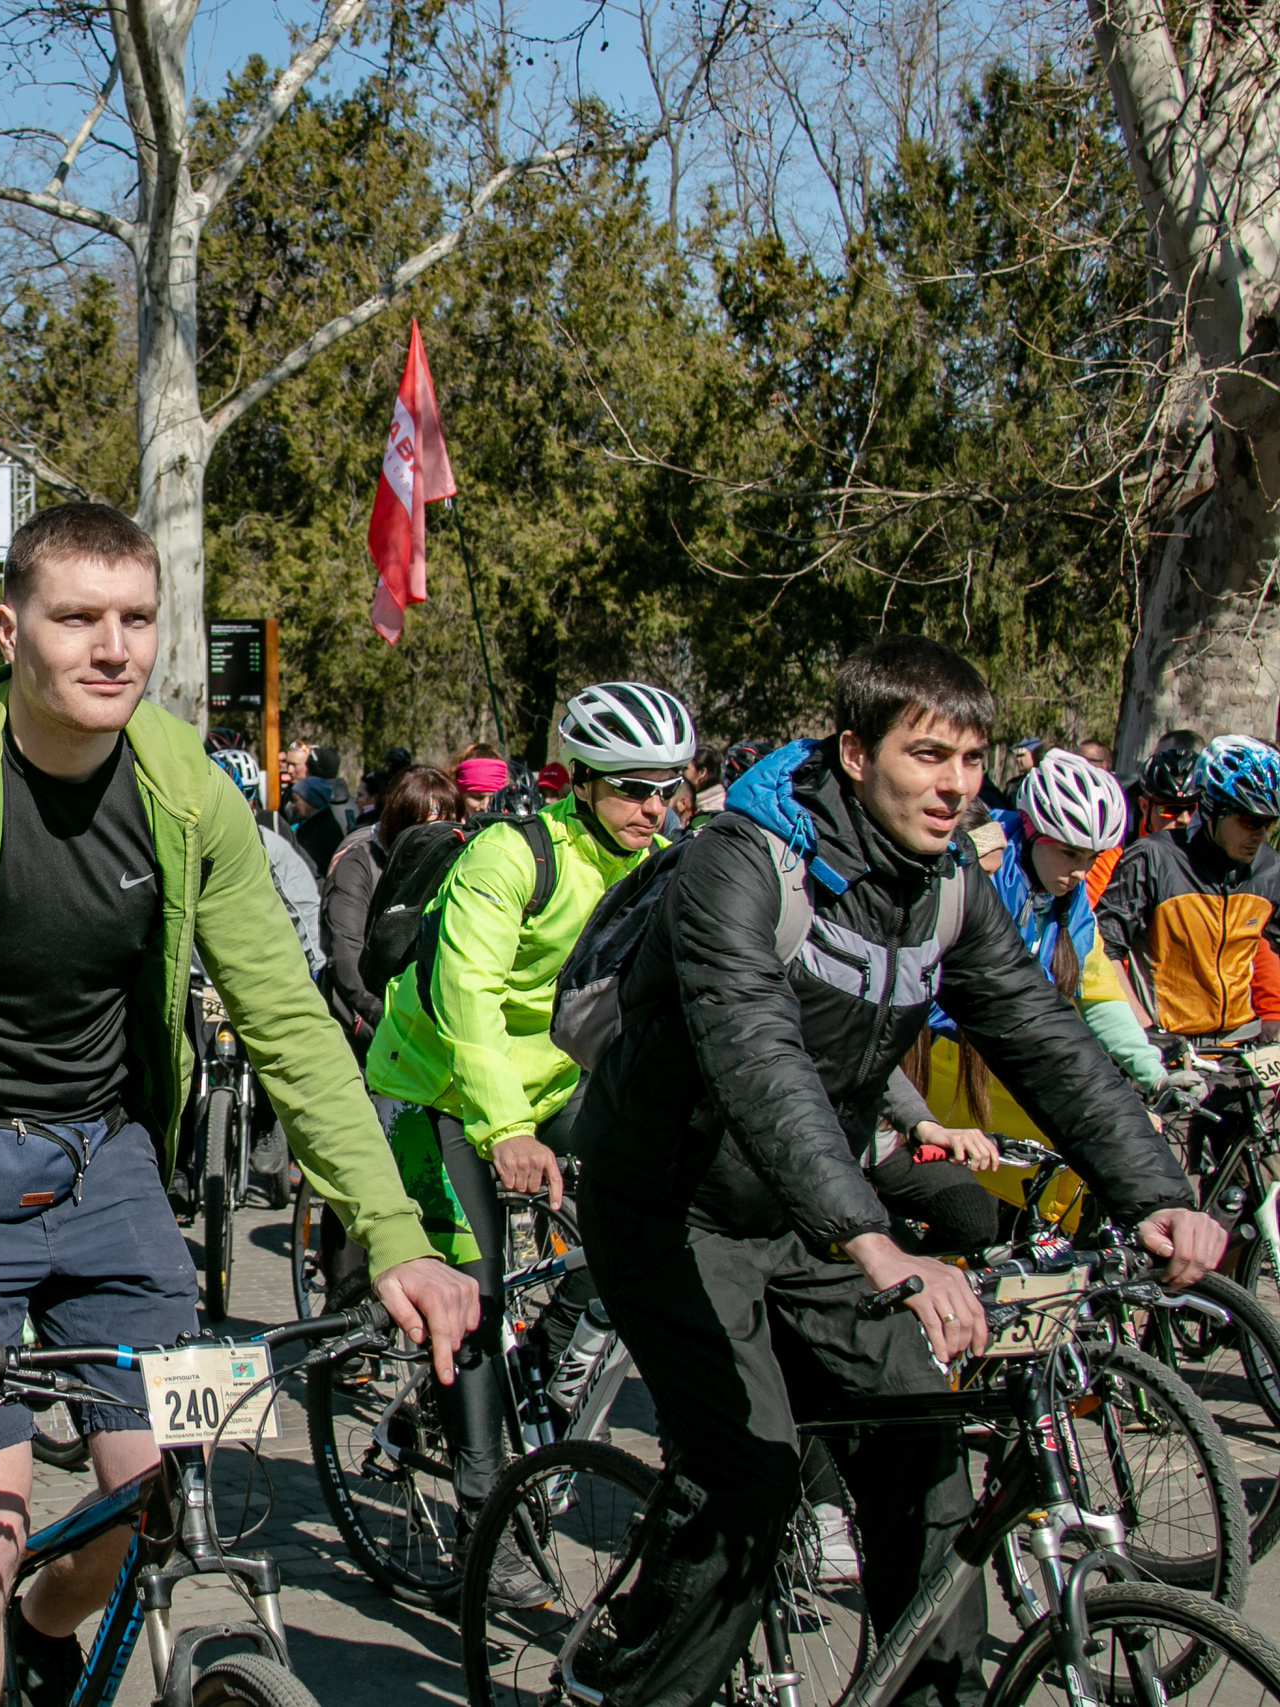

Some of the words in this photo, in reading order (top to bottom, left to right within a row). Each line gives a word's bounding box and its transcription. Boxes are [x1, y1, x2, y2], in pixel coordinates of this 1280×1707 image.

[163, 1374, 201, 1383] УКРПОШТА
[165, 1386, 220, 1431] 240
[854, 1564, 954, 1707] FOCUS
